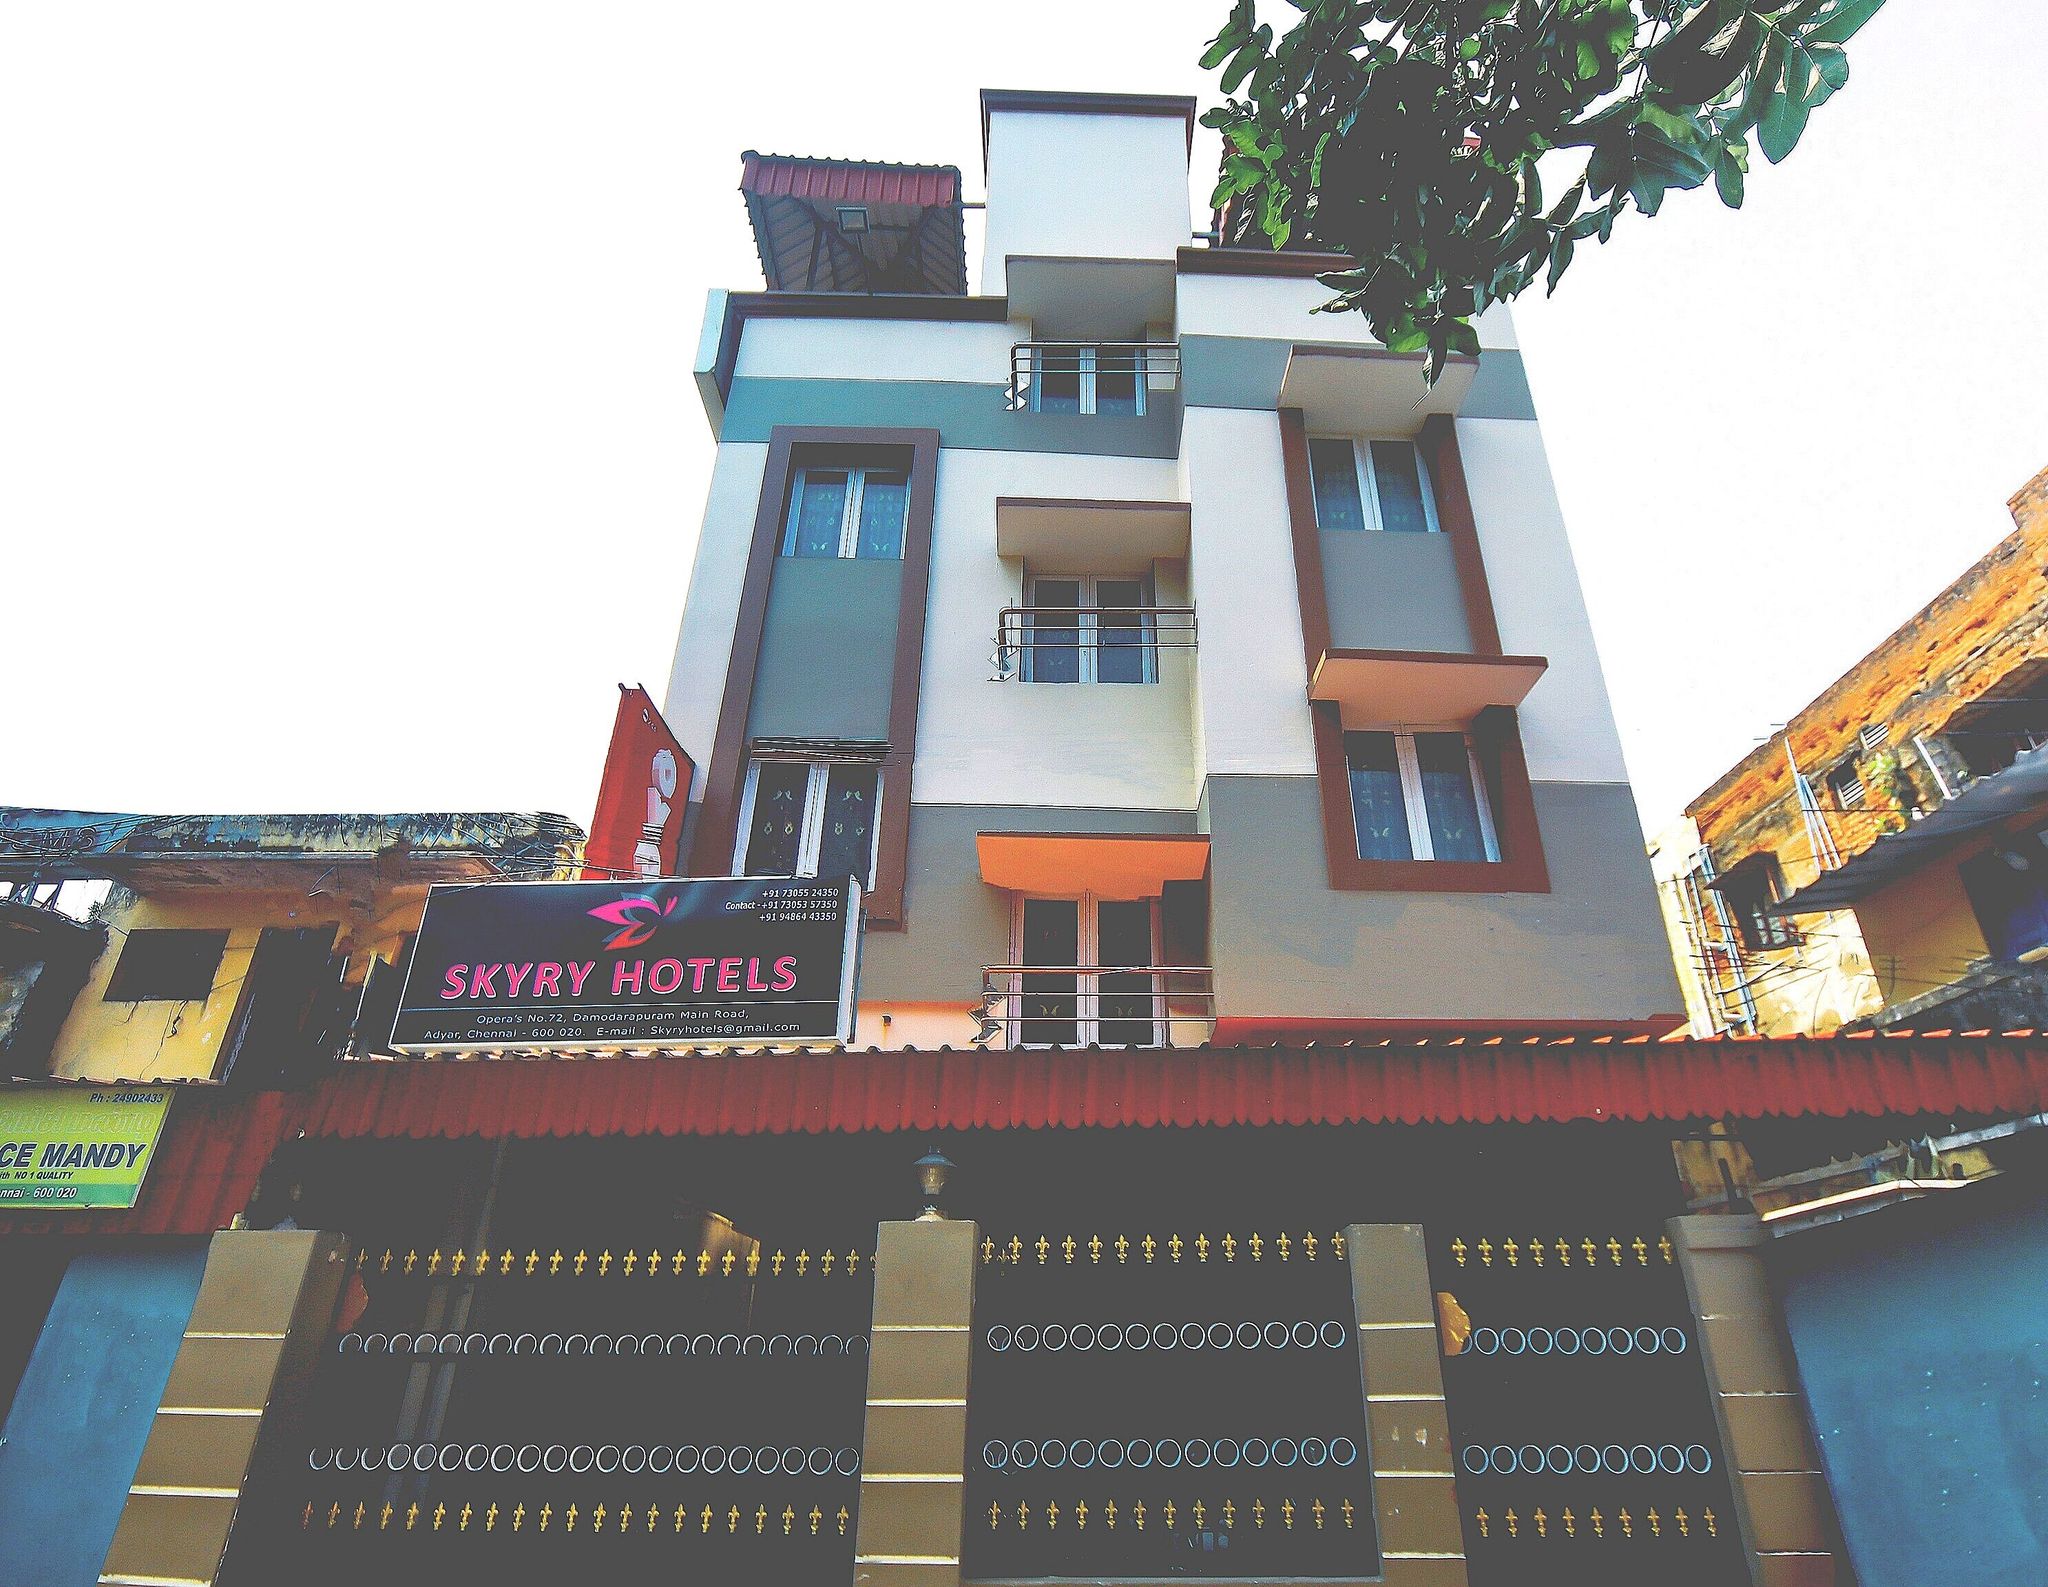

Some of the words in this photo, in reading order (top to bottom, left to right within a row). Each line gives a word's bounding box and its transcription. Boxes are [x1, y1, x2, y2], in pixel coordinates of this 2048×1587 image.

[762, 889, 779, 898] +91
[781, 889, 809, 898] 73055
[811, 888, 839, 897] 24350
[725, 900, 756, 910] Contact
[780, 900, 807, 909] 73053
[810, 900, 838, 909] 57350
[759, 913, 776, 922] +91
[779, 913, 807, 921] 94864
[809, 912, 837, 921] 43350
[440, 960, 596, 1000] SKYRY
[610, 956, 797, 995] HOTELS
[476, 1014, 523, 1026] Opera's
[527, 1013, 567, 1024] No.72,
[573, 1011, 675, 1023] Damodarapuram
[680, 1010, 709, 1020] Main
[714, 1009, 749, 1020] Road,
[424, 1029, 462, 1040] Adyar,
[467, 1028, 517, 1039] Chennai
[531, 1028, 555, 1038] 600
[596, 1026, 636, 1037] E-mail
[650, 1023, 801, 1036] Skyryhotels@gmail.com
[90, 1093, 104, 1103] Ph
[0, 1142, 38, 1168] CE
[39, 1143, 147, 1168] MANDY
[14, 1171, 28, 1180] NO
[29, 1171, 35, 1180] 1
[36, 1171, 74, 1180] QUALITY
[33, 1187, 55, 1198] 600
[56, 1187, 78, 1198] 020
